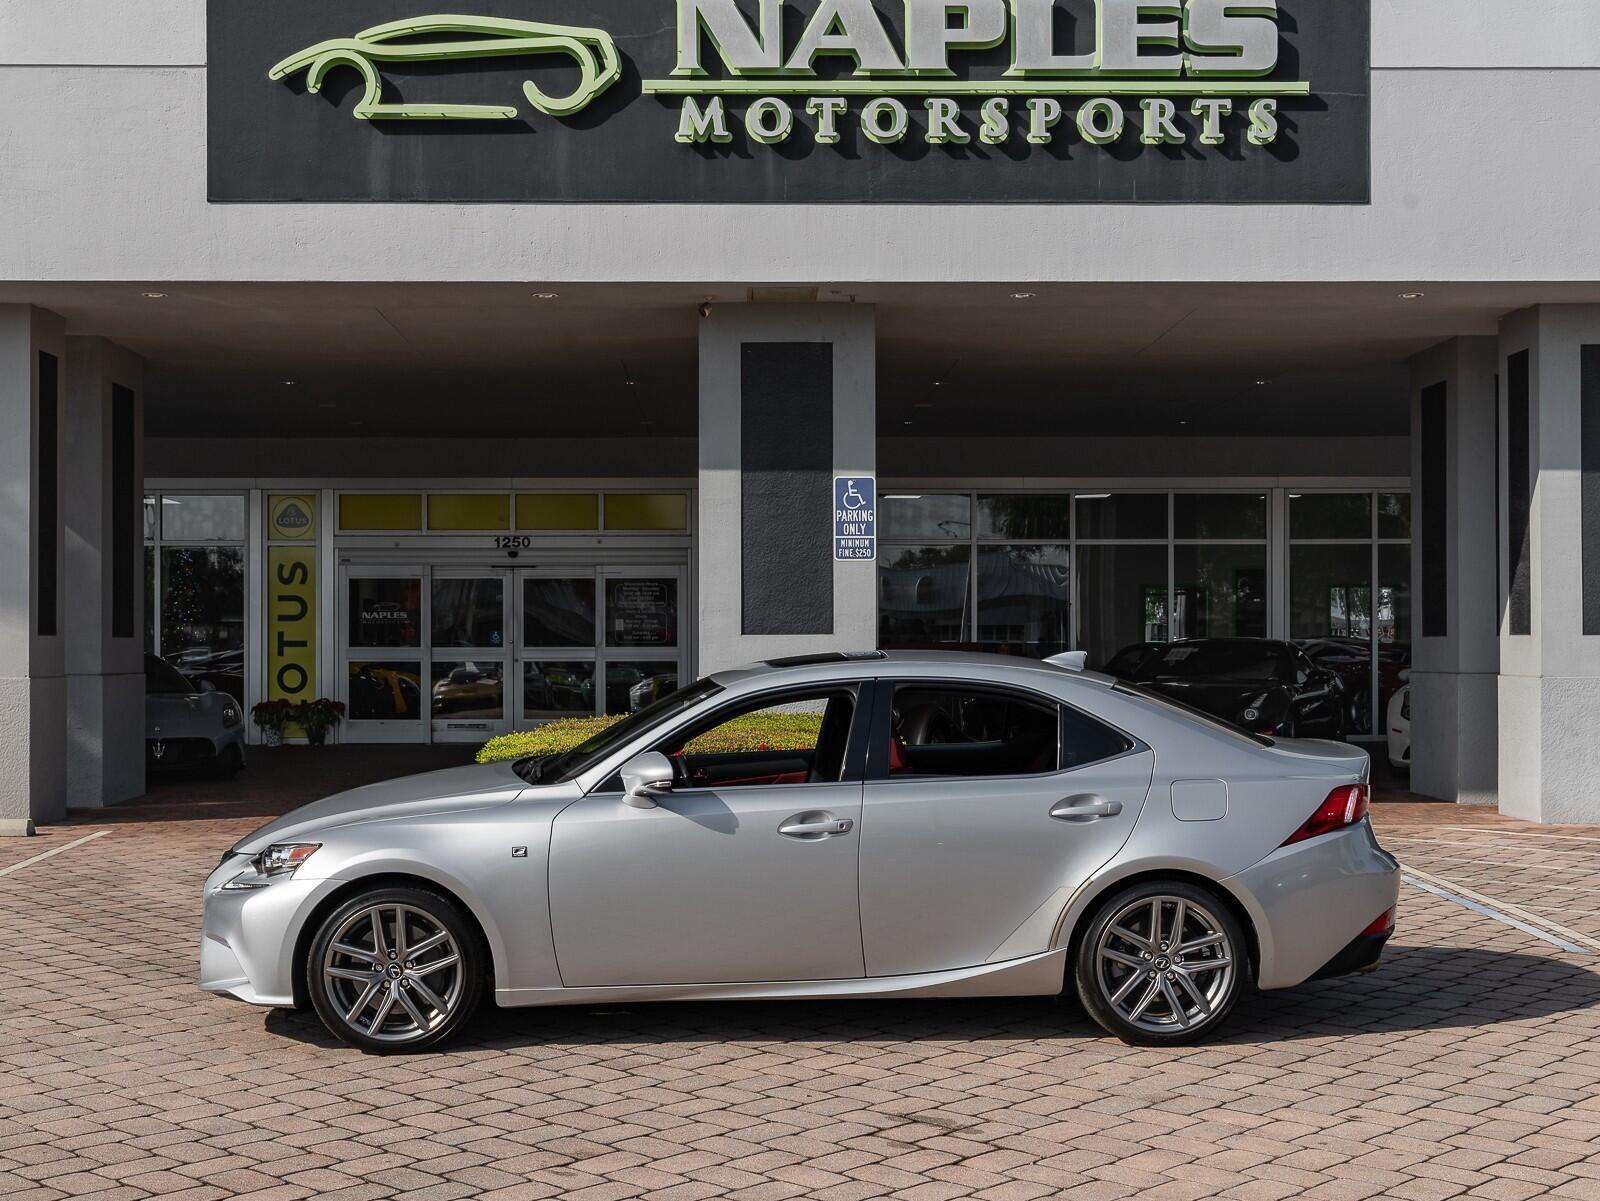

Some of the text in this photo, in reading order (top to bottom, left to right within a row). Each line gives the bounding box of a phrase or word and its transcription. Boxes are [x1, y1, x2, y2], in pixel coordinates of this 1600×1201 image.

[669, 0, 1280, 77] NAPLES
[675, 96, 1279, 144] MOTORSPORTS
[278, 516, 308, 525] LOTUS
[836, 510, 873, 522] PARKING
[843, 523, 866, 535] ONLY
[494, 536, 531, 548] 1250
[841, 539, 869, 547] MINIMUM
[838, 548, 871, 558] FINE $250
[361, 611, 408, 619] NAPLES
[277, 561, 309, 718] OTUS
